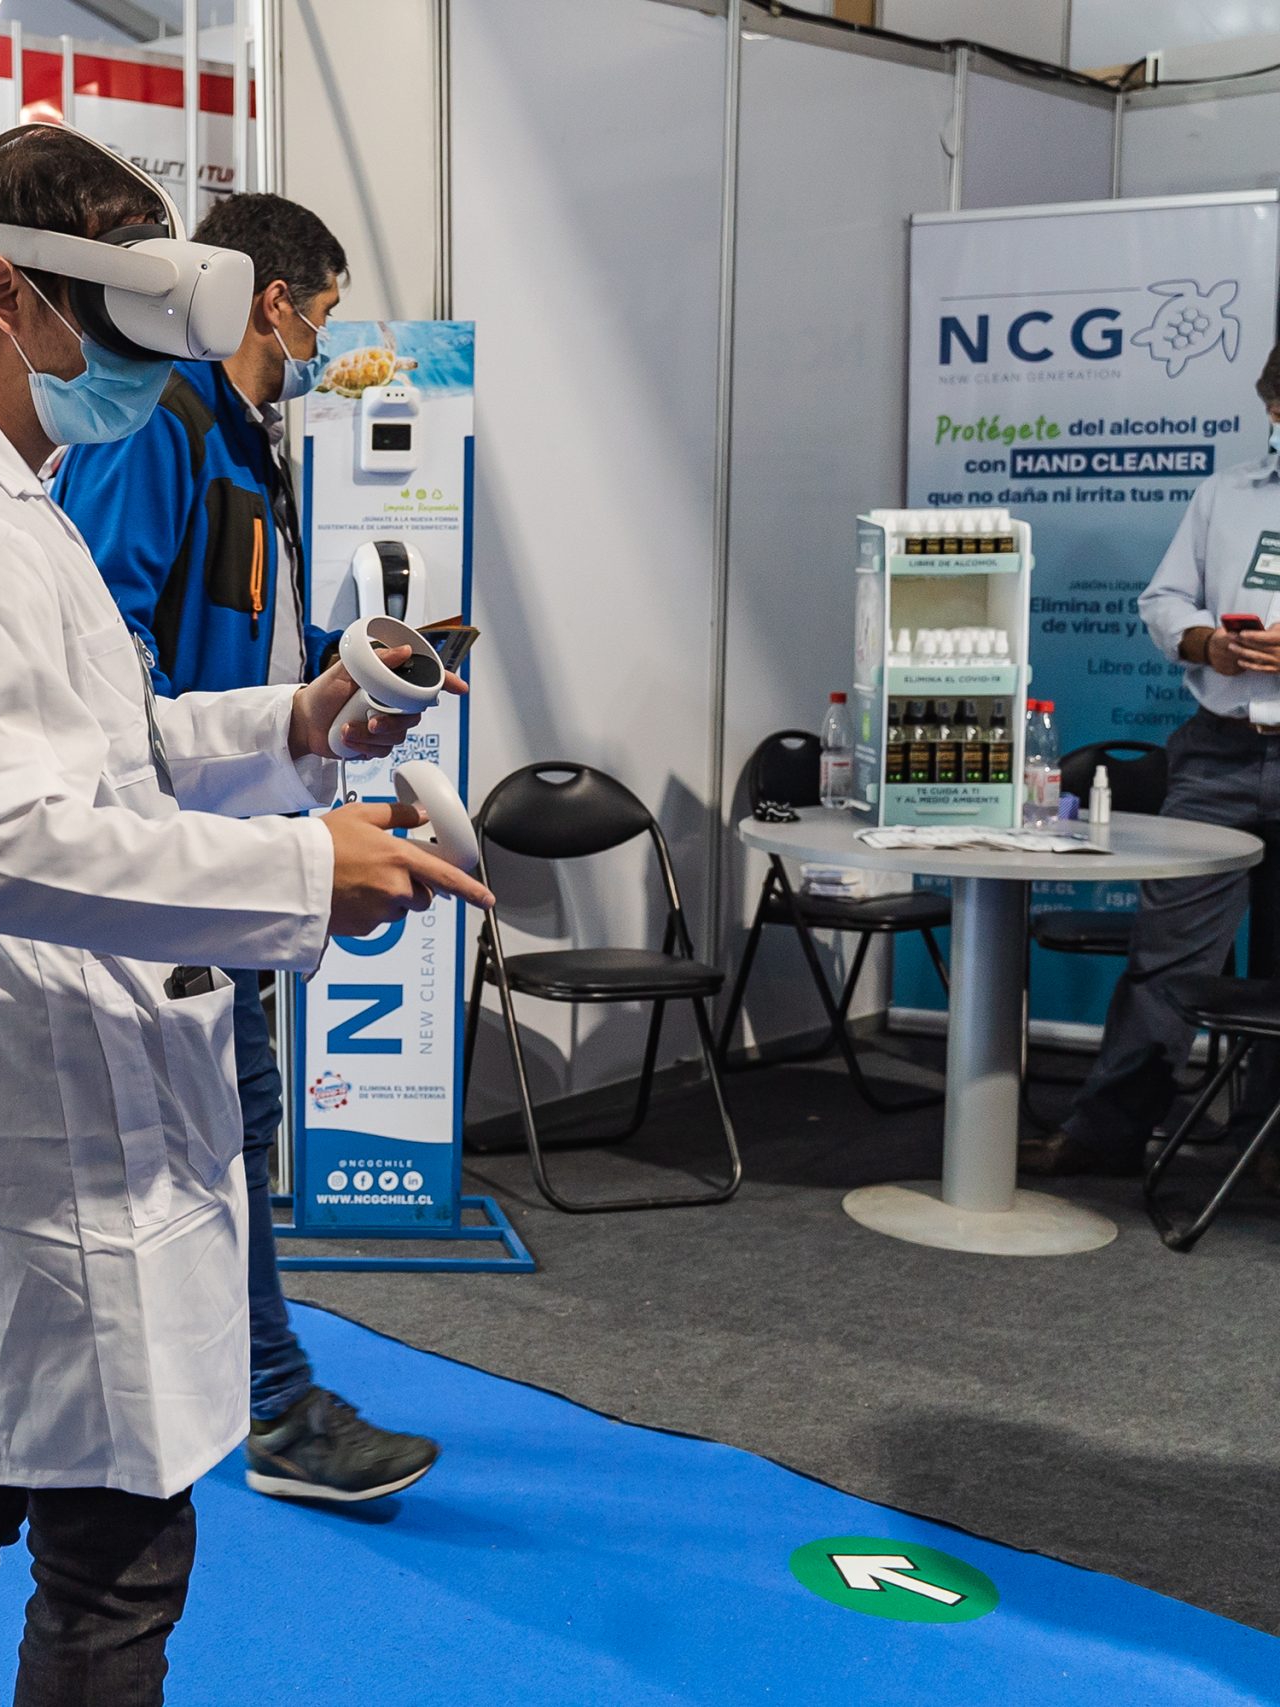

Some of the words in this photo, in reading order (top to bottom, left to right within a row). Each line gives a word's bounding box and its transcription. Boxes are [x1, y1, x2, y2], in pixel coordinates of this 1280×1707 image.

[939, 307, 1123, 366] NCG
[938, 374, 969, 386] NEW
[974, 372, 1020, 384] CLEAN
[1026, 368, 1121, 383] GENERATION
[934, 414, 1062, 446] Protégete
[1068, 418, 1104, 437] del
[1109, 416, 1196, 435] alcohol
[1202, 415, 1239, 438] gel
[964, 458, 1006, 475] con
[1014, 454, 1087, 475] HAND
[1091, 450, 1208, 474] CLEANER
[926, 491, 964, 508] que
[967, 489, 993, 505] no
[997, 487, 1048, 505] daña
[1052, 486, 1071, 503] ni
[1076, 486, 1126, 503] irrita
[1130, 486, 1164, 502] tus
[1071, 618, 1120, 634] virus
[420, 937, 436, 1002] CLEAN
[419, 1010, 434, 1054] NEW
